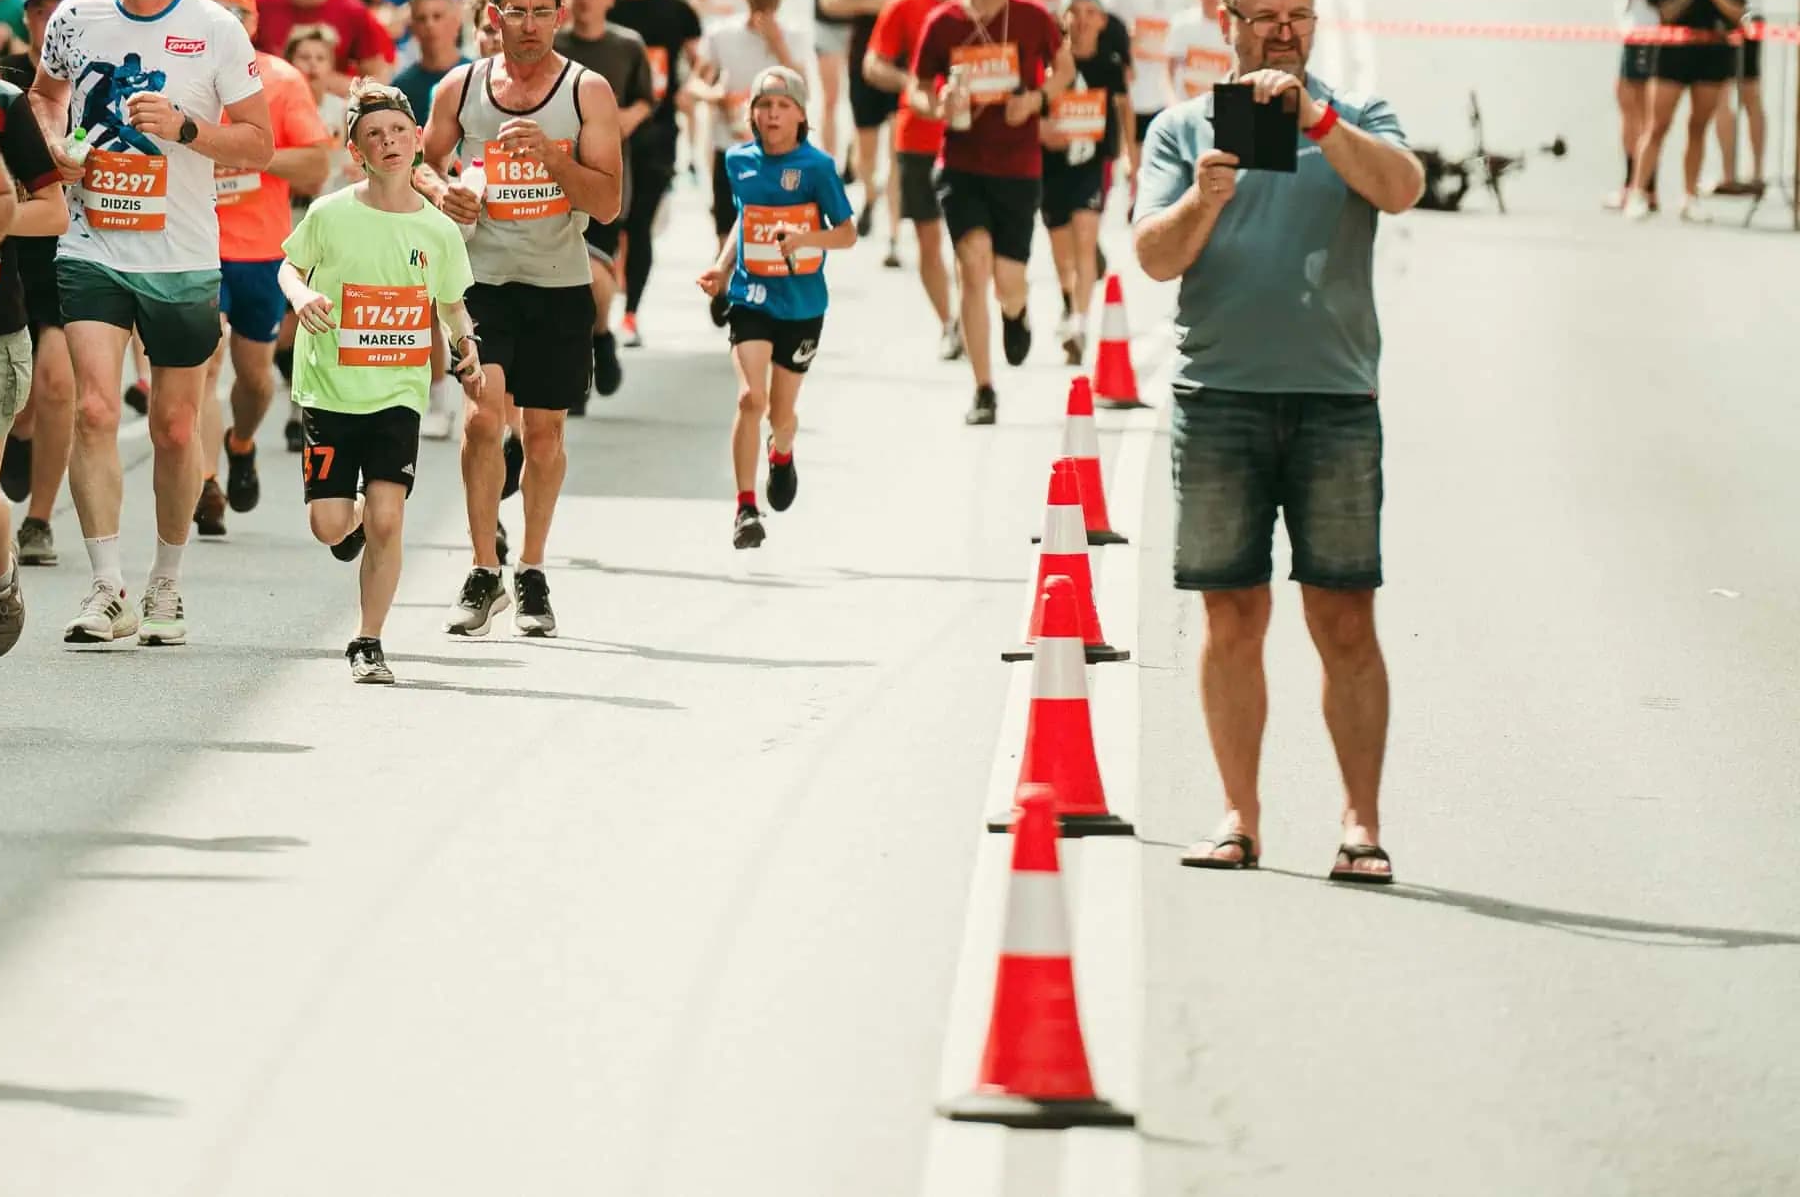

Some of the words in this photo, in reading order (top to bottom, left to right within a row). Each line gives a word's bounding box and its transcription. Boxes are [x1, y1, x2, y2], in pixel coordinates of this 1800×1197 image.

[496, 161, 549, 181] 1834
[91, 169, 156, 193] 23297
[496, 186, 562, 200] JEVGENIJS
[101, 197, 142, 211] DIDZIS
[354, 306, 423, 326] 17477
[359, 334, 416, 345] MAREKS
